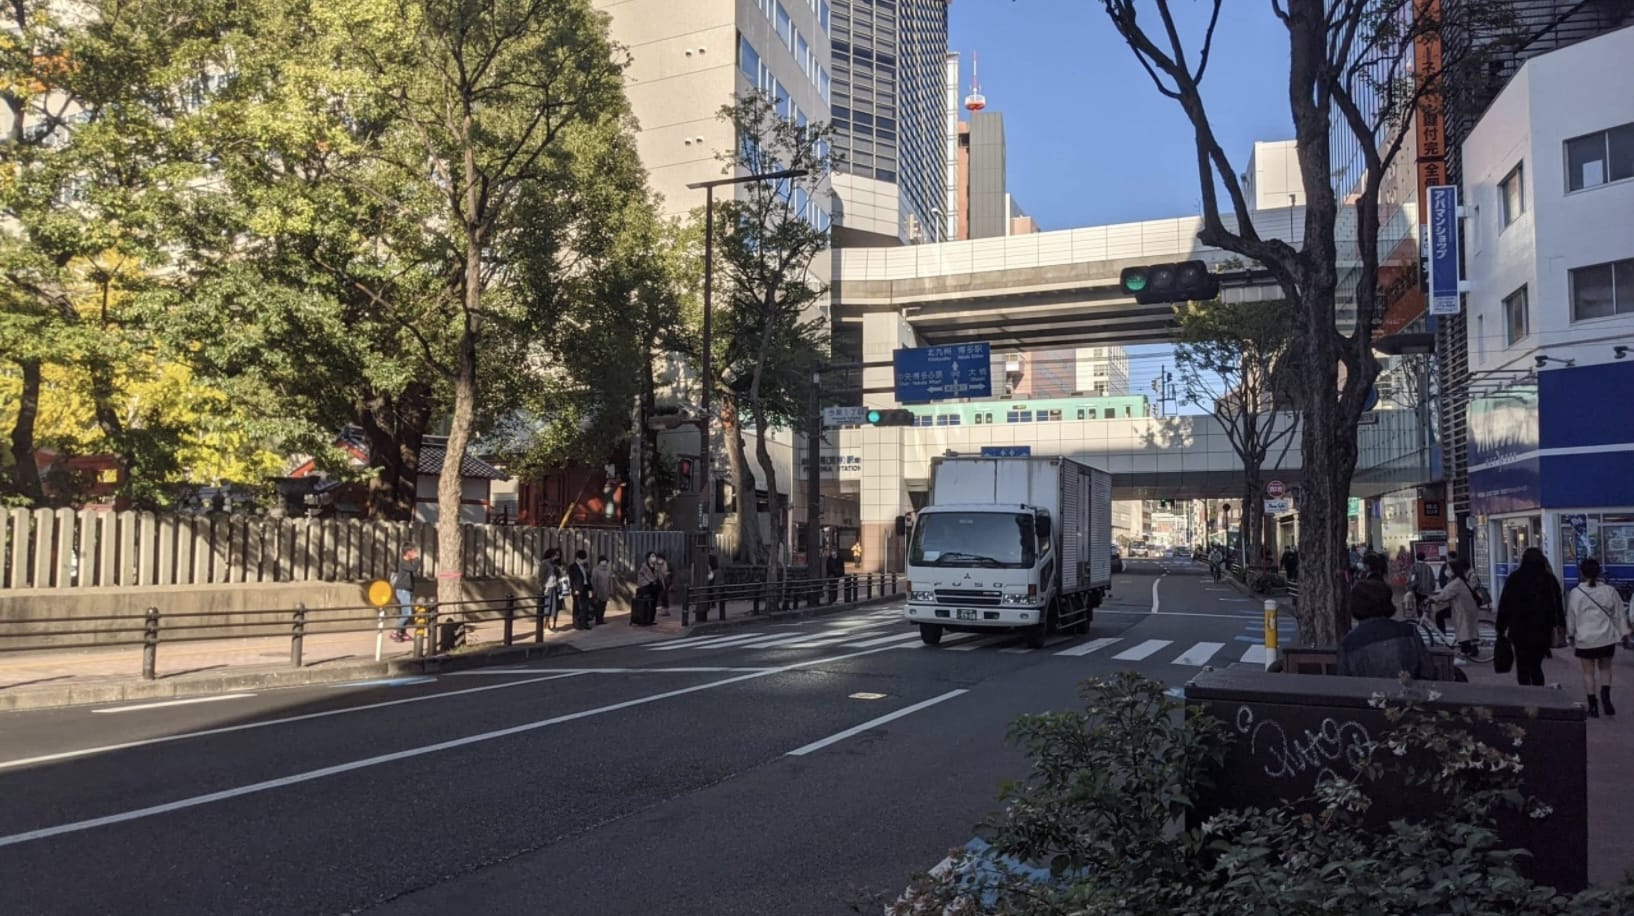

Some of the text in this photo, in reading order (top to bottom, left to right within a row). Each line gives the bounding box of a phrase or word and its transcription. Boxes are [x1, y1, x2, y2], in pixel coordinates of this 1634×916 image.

[1434, 190, 1448, 260] アパマンショップ
